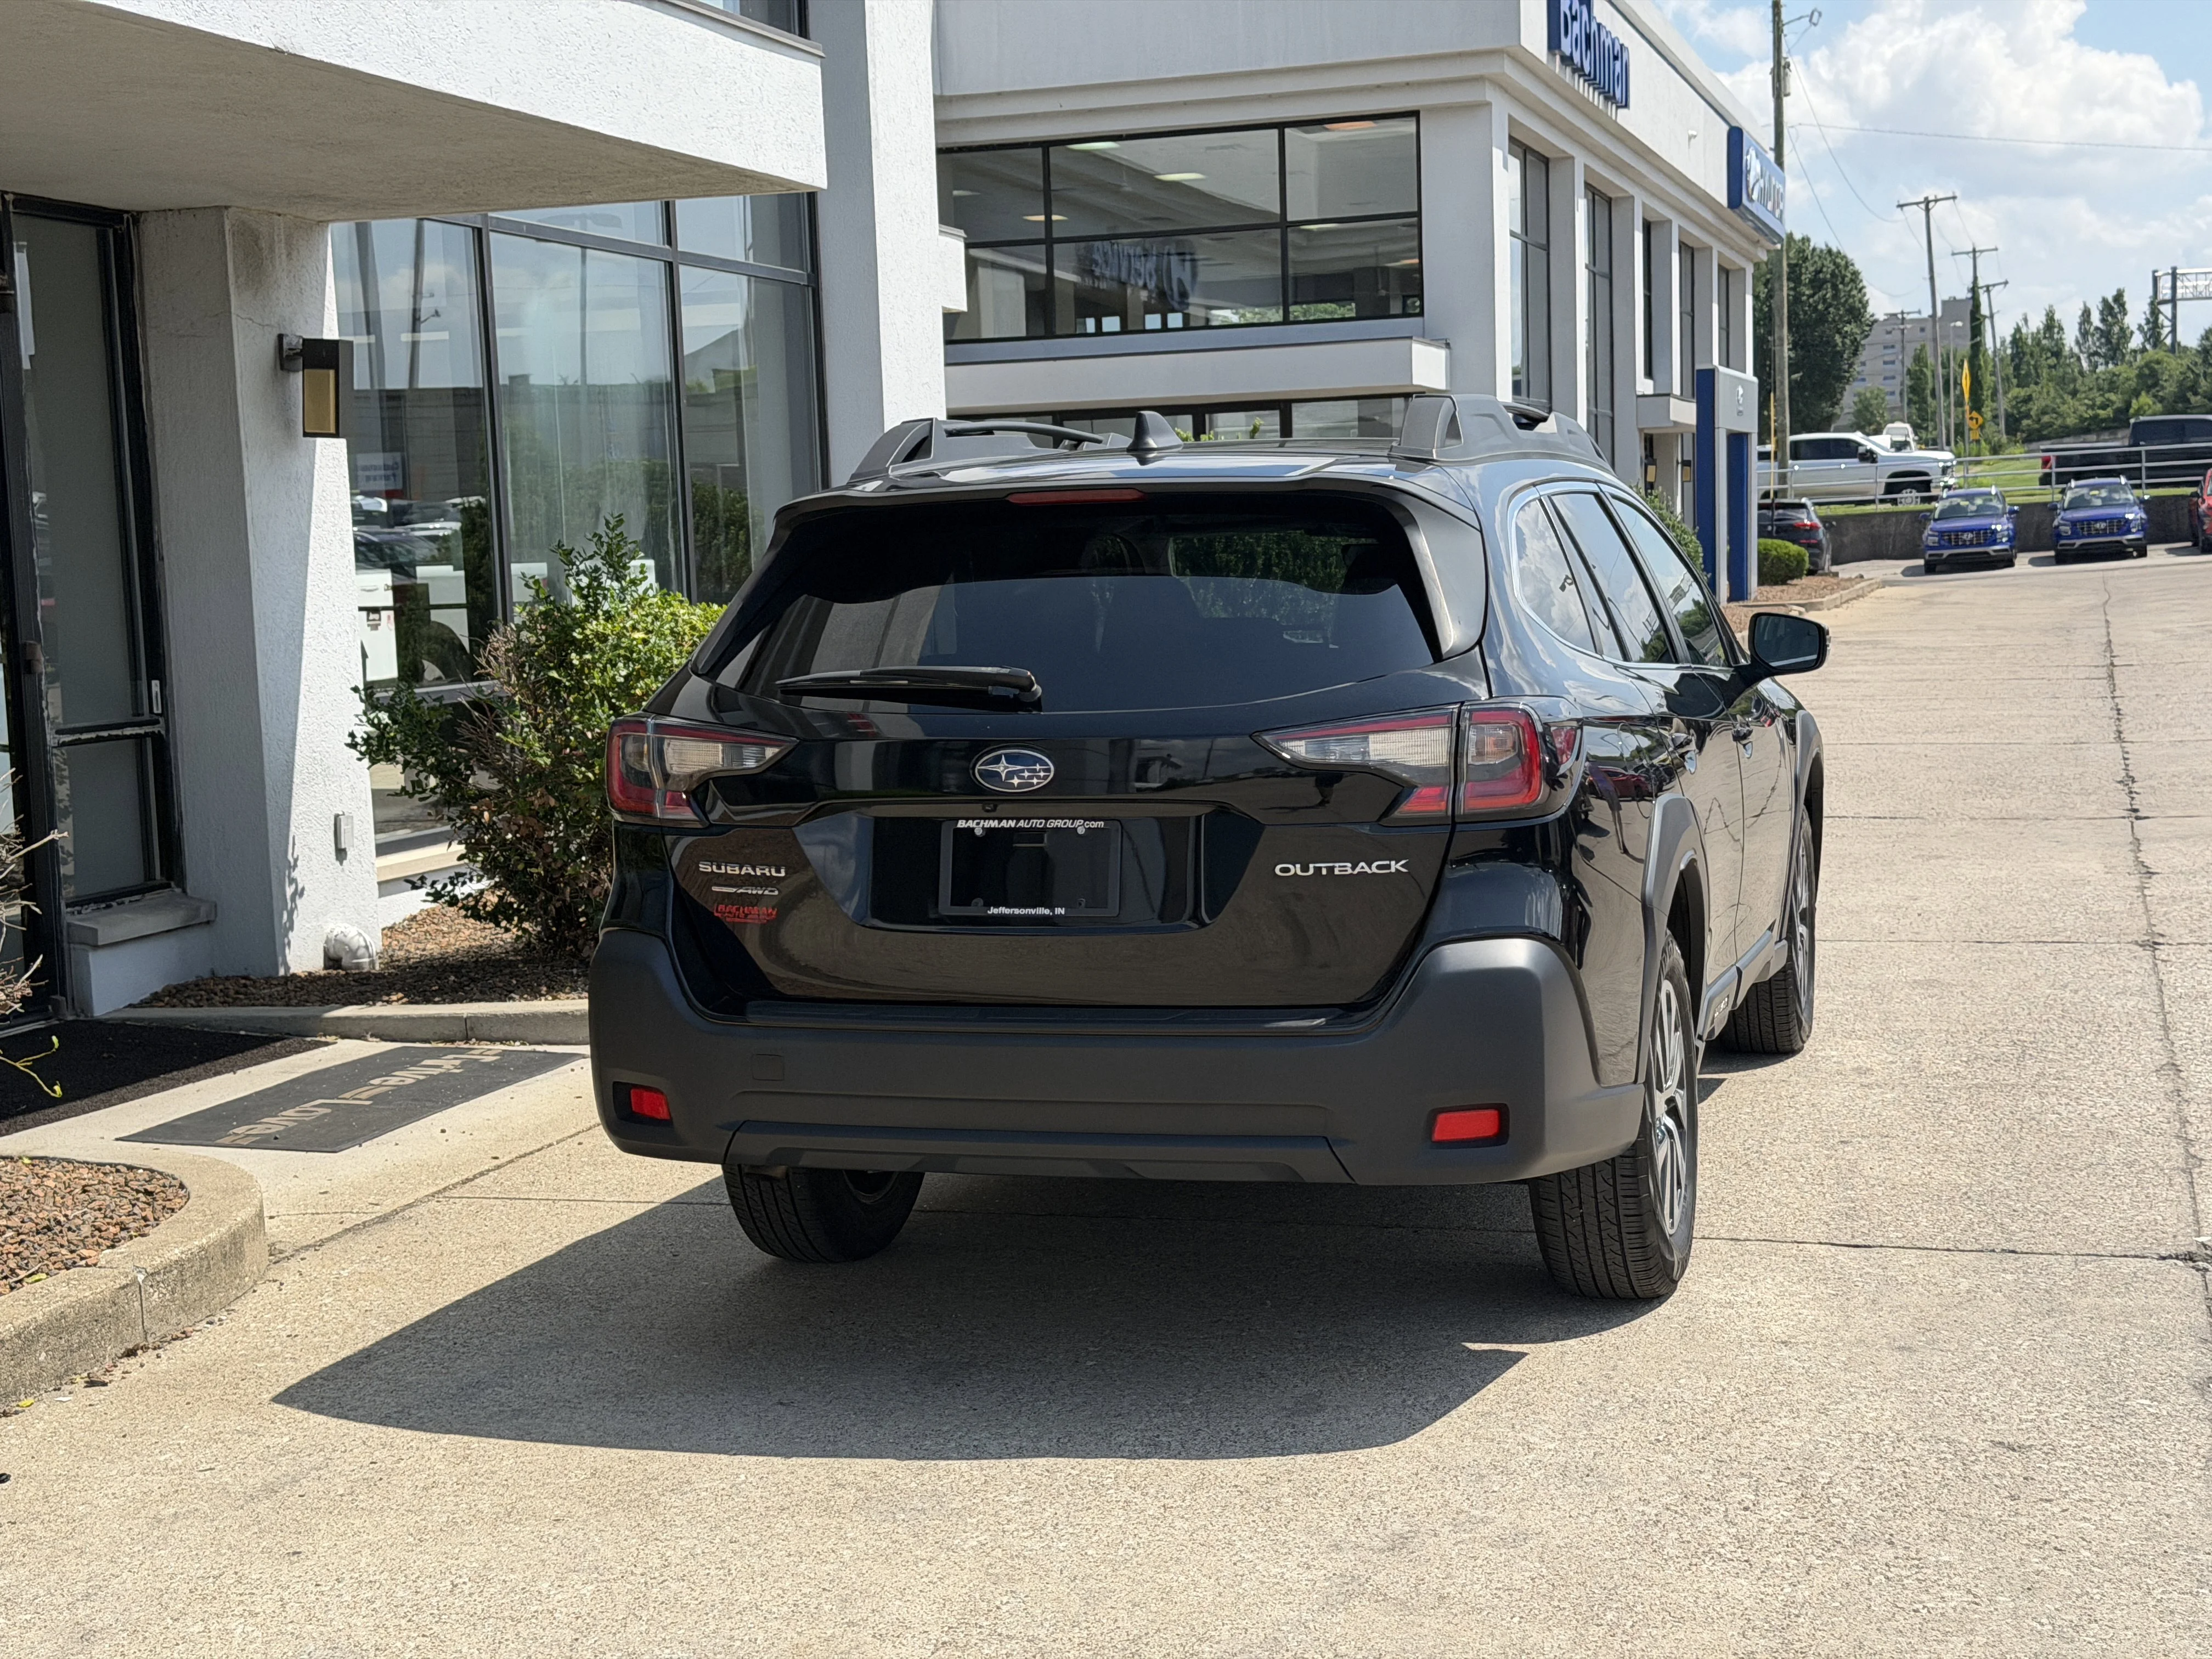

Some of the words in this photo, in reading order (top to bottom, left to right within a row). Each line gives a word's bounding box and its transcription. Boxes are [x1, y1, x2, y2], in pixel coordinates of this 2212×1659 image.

[957, 820, 1016, 828] BACHMAN
[1016, 820, 1045, 828] AUTO
[699, 861, 786, 877] SUBARU
[1274, 859, 1409, 876] OUTBACK
[988, 906, 1053, 916] Jeffersonville,
[1054, 907, 1065, 915] IN
[227, 1099, 373, 1135] Love
